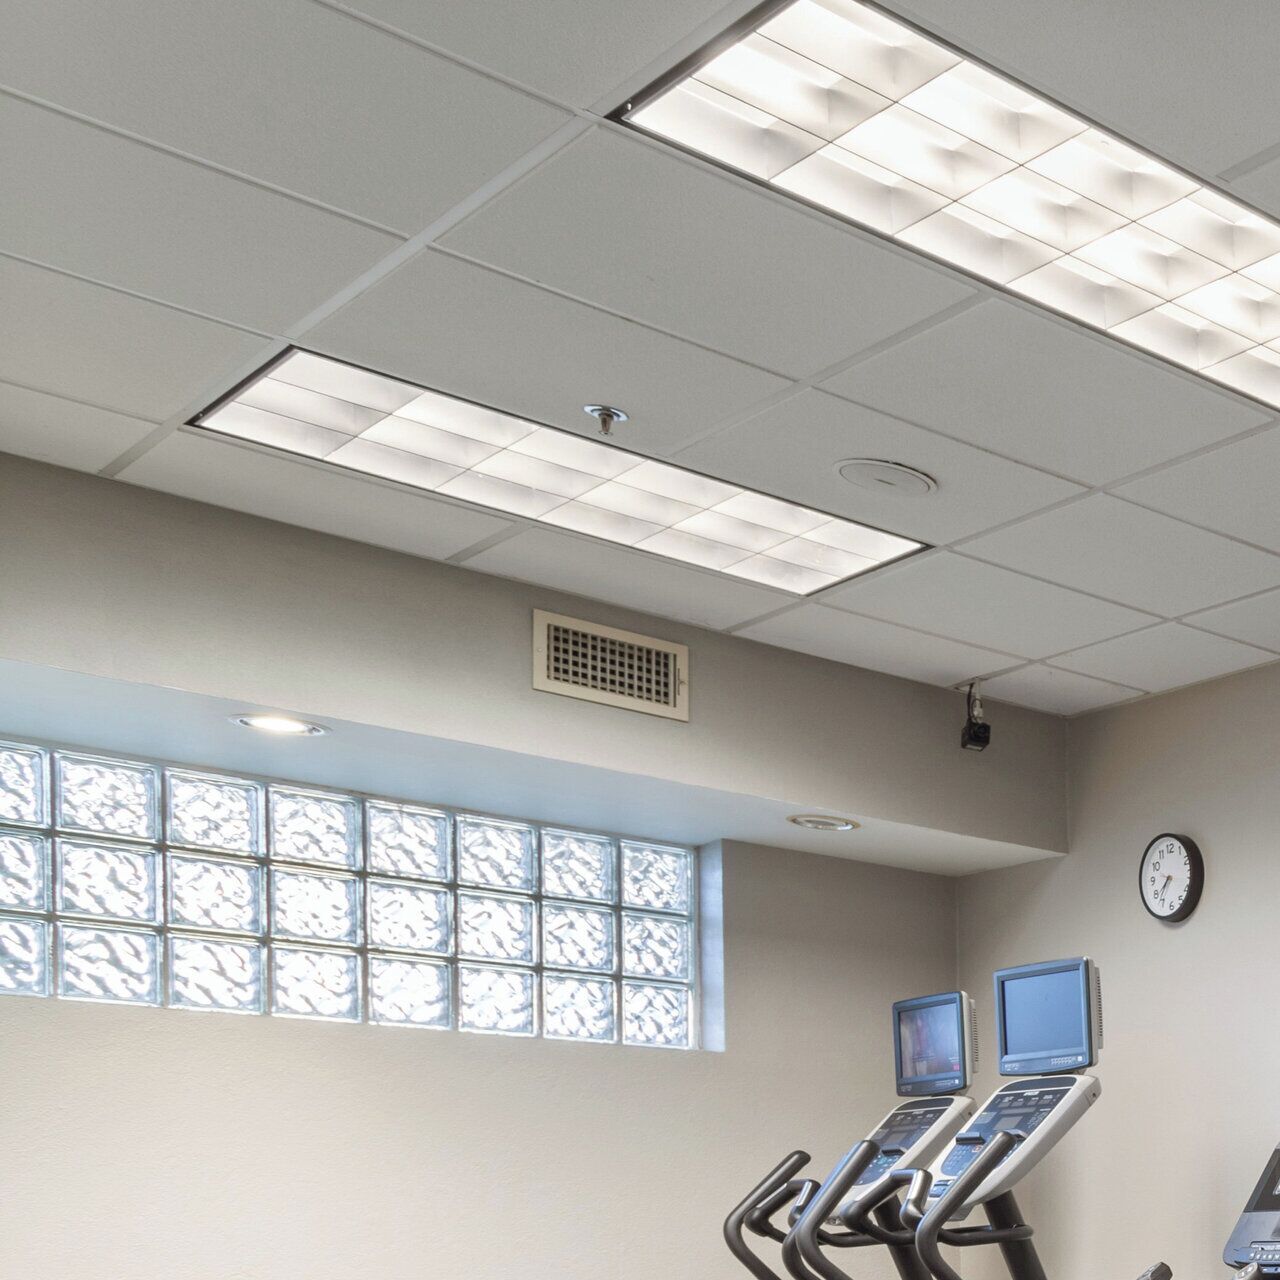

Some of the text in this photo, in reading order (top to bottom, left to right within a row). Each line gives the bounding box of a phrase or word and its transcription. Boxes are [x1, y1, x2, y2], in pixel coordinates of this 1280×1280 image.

[1166, 843, 1175, 854] 12
[1158, 850, 1165, 859] 11
[1184, 856, 1190, 866] 2
[1152, 861, 1161, 872] 10
[1150, 877, 1156, 886] 9
[1153, 890, 1159, 900] 8
[1169, 901, 1174, 911] 6
